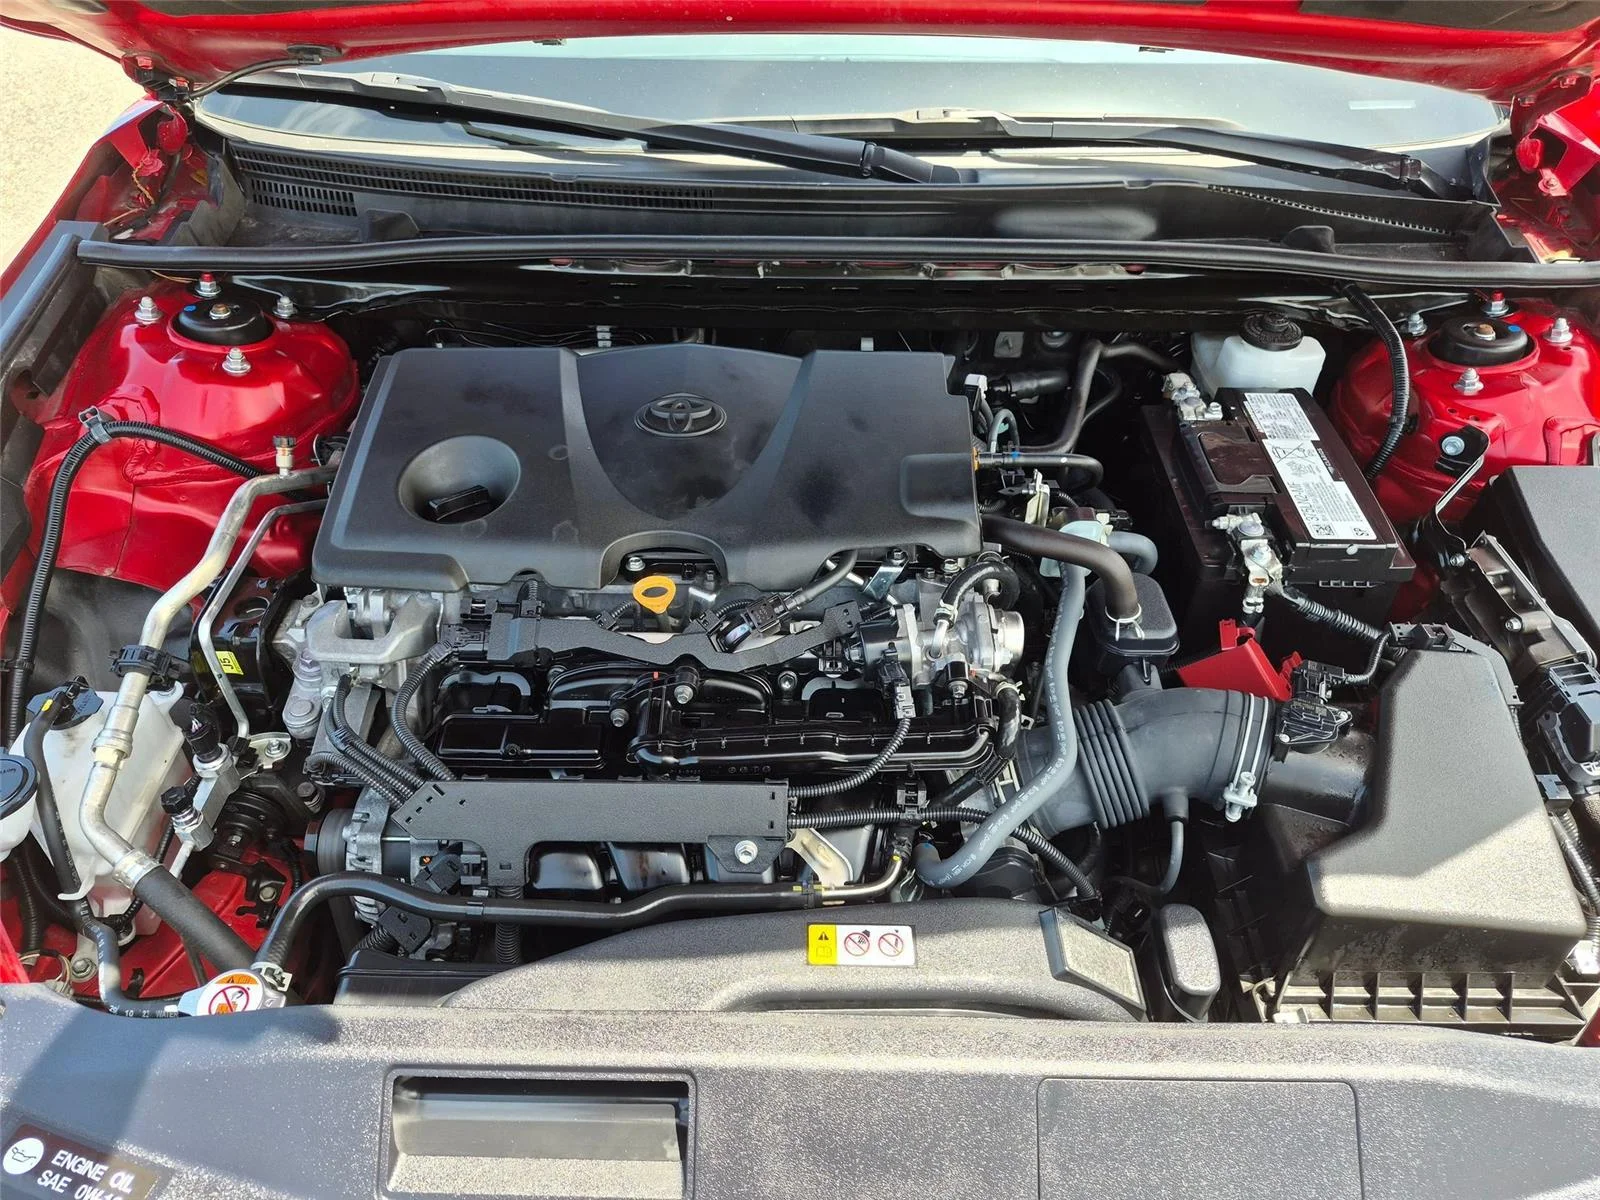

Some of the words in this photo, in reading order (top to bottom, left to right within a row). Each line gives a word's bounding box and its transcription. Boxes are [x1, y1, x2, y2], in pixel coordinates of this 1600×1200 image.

[37, 1169, 72, 1193] SAE
[74, 1184, 123, 1200] 0W-
[51, 1149, 109, 1182] ENGINE
[109, 1171, 135, 1194] OIL
